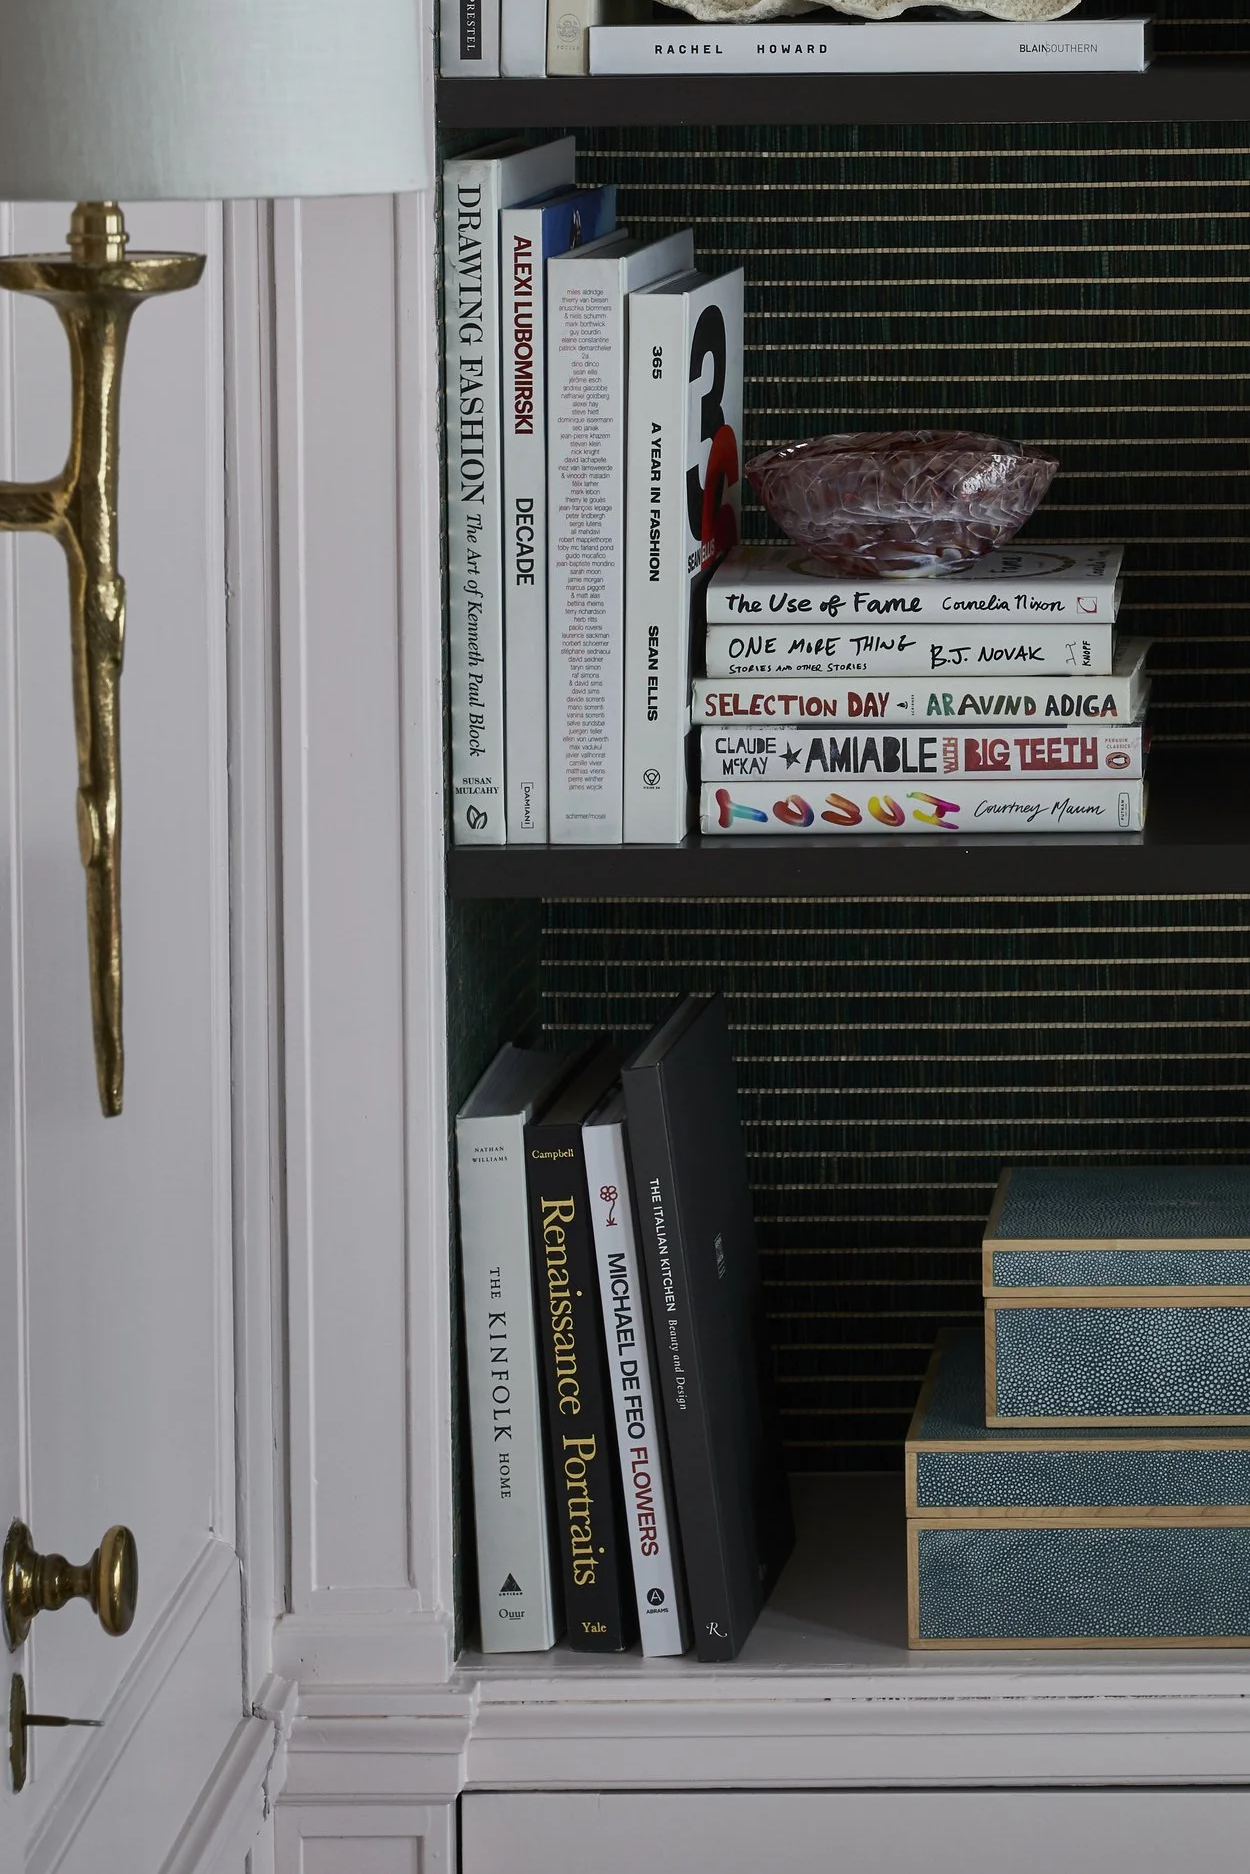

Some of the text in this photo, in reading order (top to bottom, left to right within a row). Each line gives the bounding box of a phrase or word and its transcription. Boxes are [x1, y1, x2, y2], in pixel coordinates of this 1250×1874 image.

[654, 45, 829, 54] RACHEL HOWARD
[457, 183, 485, 505] DRAWING FASHION
[513, 235, 534, 435] ALEXI LUBOMIRSKI
[652, 346, 662, 380] 365
[650, 438, 661, 582] YEAR FASHION
[516, 498, 534, 586] DECADE
[854, 593, 923, 614] Fame
[942, 596, 1010, 611] Cornelia
[729, 635, 917, 658] ONE THING
[930, 645, 1044, 669] B.J. NOVAK
[467, 599, 485, 757] Kenneth Block
[648, 626, 659, 722] SEAN ELLIS
[705, 692, 890, 717] SELECTION DAY
[926, 693, 1118, 717] ARAVIND ADIGA
[715, 737, 777, 755] CLAUDE
[805, 737, 1098, 773] AMIABLE BIG TEETH
[455, 786, 499, 795] MULCAHY
[463, 777, 492, 785] SUSAN
[974, 800, 1049, 823] Courtney
[532, 1149, 574, 1160] Campbell
[653, 1206, 676, 1312] ITALIAN KITCHEN
[540, 1196, 605, 1586] Renaissance Portraits
[488, 1312, 512, 1499] KINFOLK HOME
[607, 1253, 659, 1557] MICHAEL FLOWERS
[581, 1622, 607, 1633] Yale
